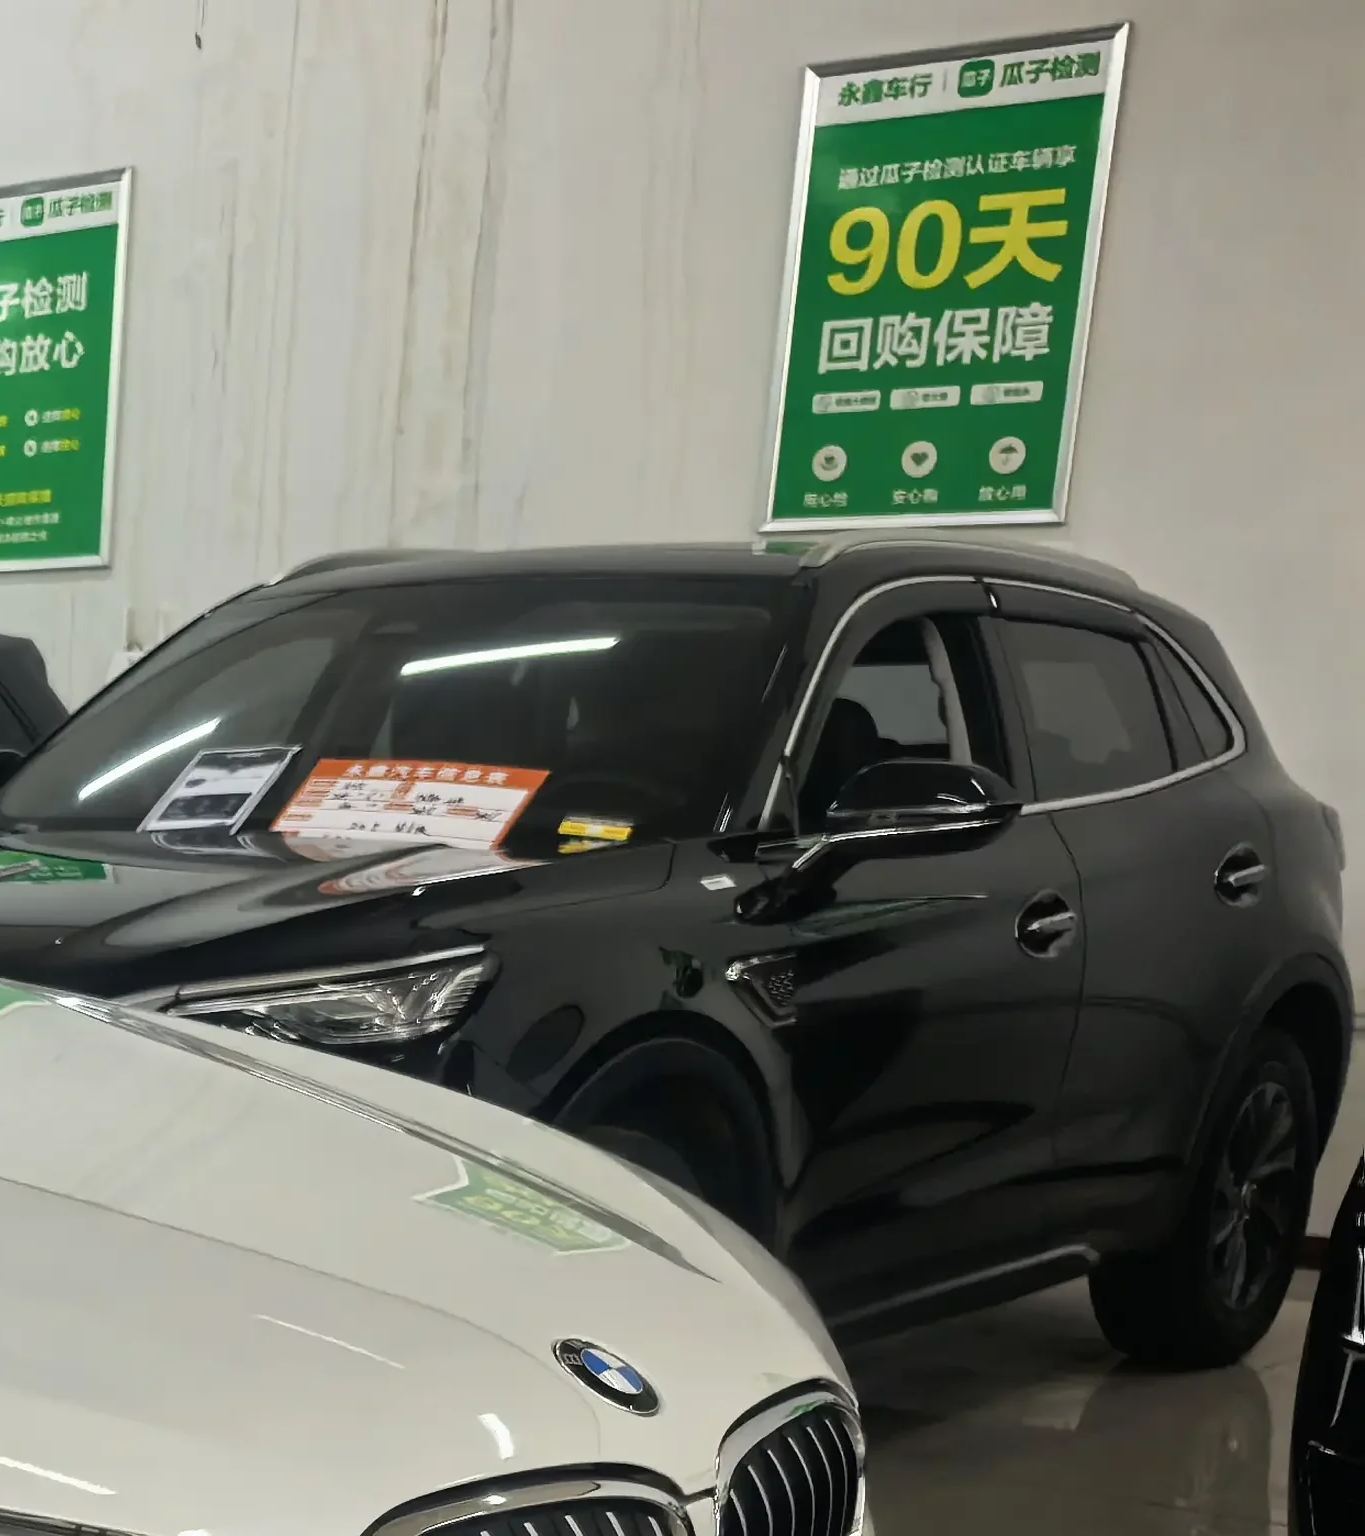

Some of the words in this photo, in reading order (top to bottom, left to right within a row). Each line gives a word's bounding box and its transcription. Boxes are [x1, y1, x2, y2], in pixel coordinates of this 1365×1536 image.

[999, 51, 1102, 88] 瓜子检测
[827, 188, 1069, 296] 90天
[817, 302, 1055, 374] 回购保障
